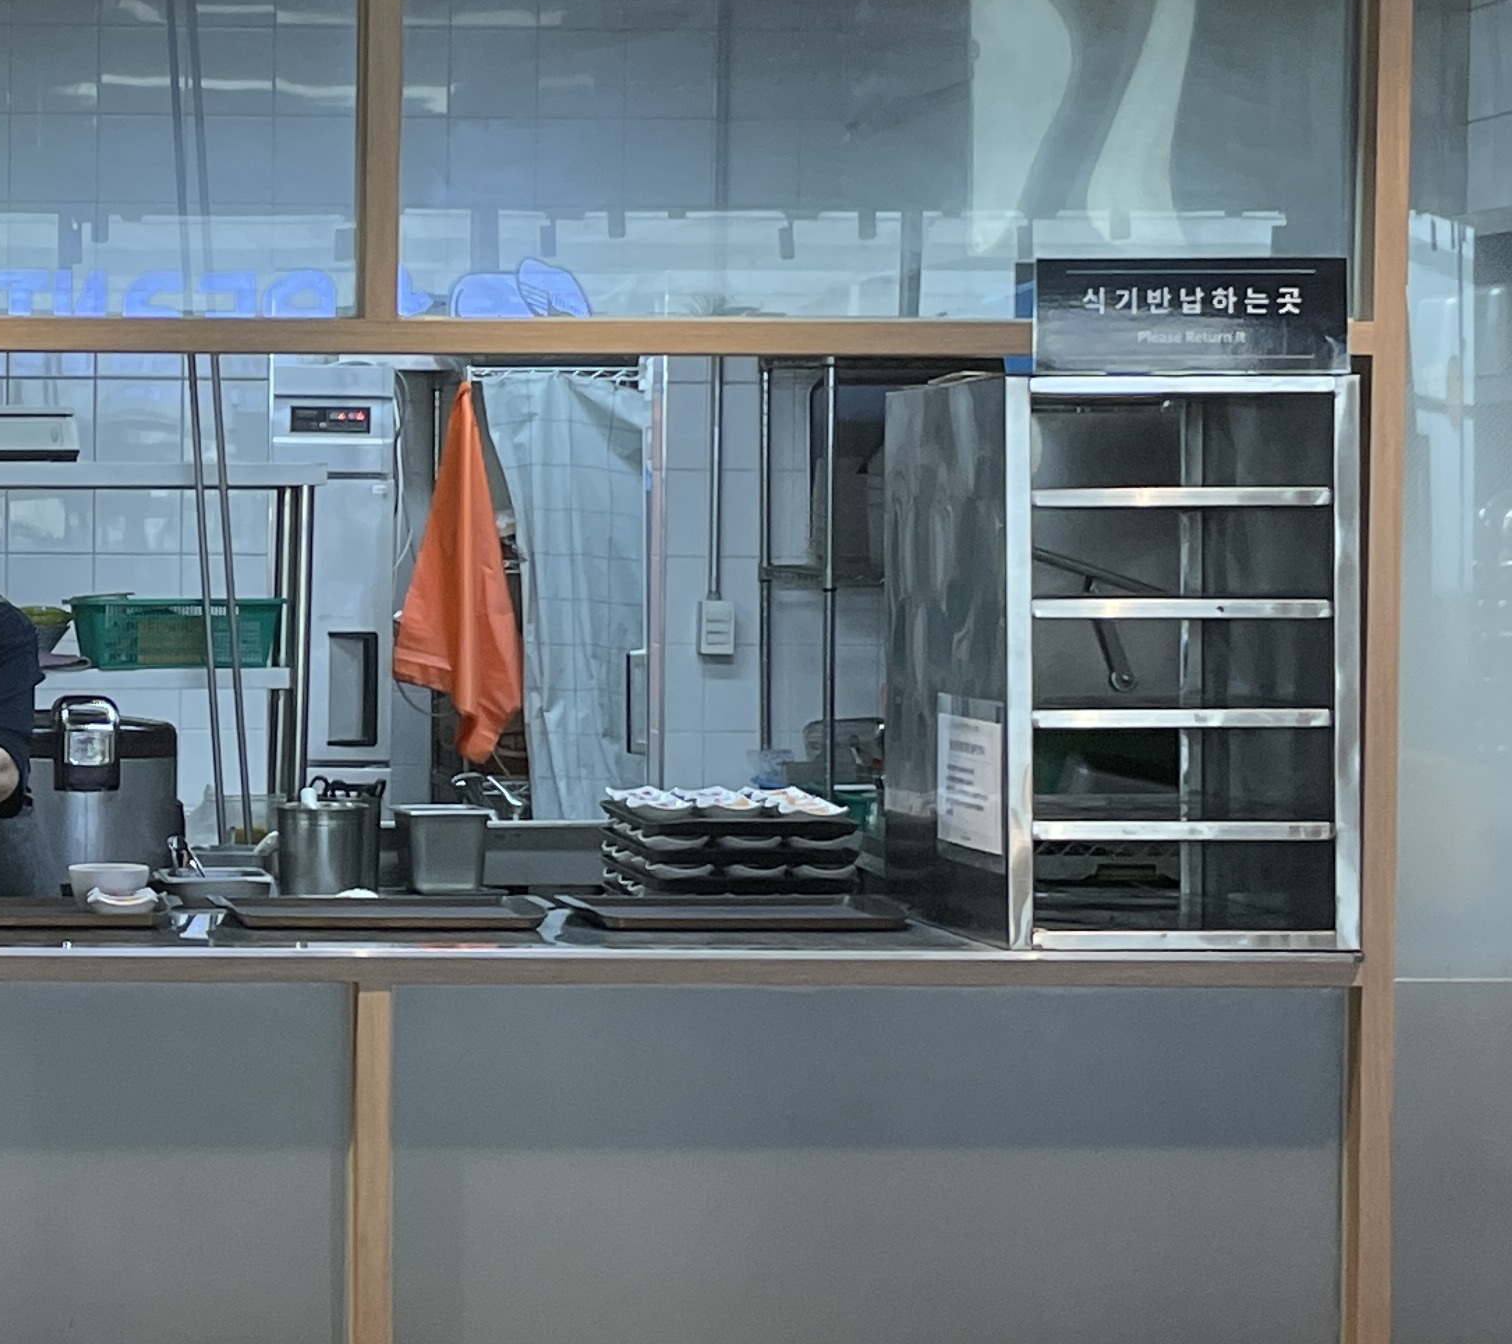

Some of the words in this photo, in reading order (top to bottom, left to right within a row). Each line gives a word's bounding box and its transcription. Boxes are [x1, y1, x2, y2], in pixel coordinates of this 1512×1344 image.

[1082, 286, 1303, 315] 식기반납하는곳
[1137, 330, 1182, 344] Please
[1186, 331, 1232, 344] Return
